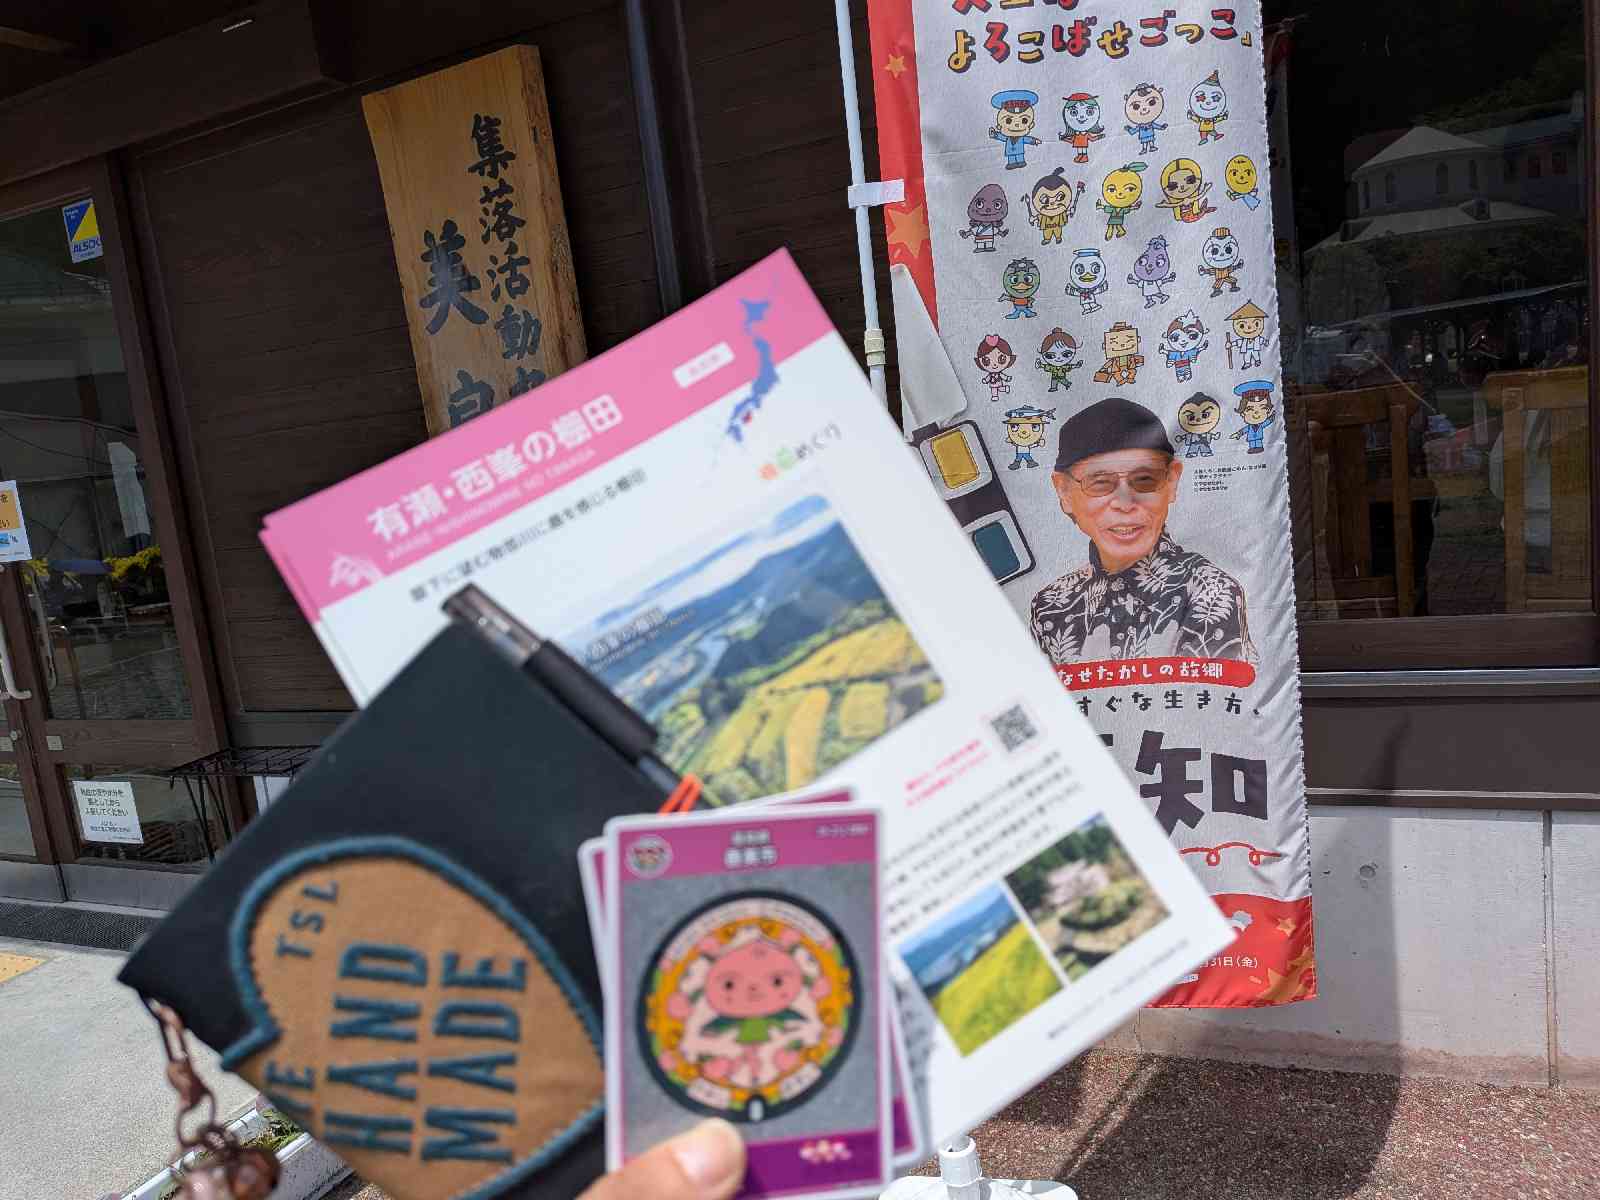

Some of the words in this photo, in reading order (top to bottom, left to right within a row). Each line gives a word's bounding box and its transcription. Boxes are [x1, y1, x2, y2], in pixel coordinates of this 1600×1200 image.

[1098, 729, 1269, 839] 知
[274, 880, 340, 961] TSL
[323, 942, 428, 1157] HAND
[420, 951, 528, 1164] MADE
